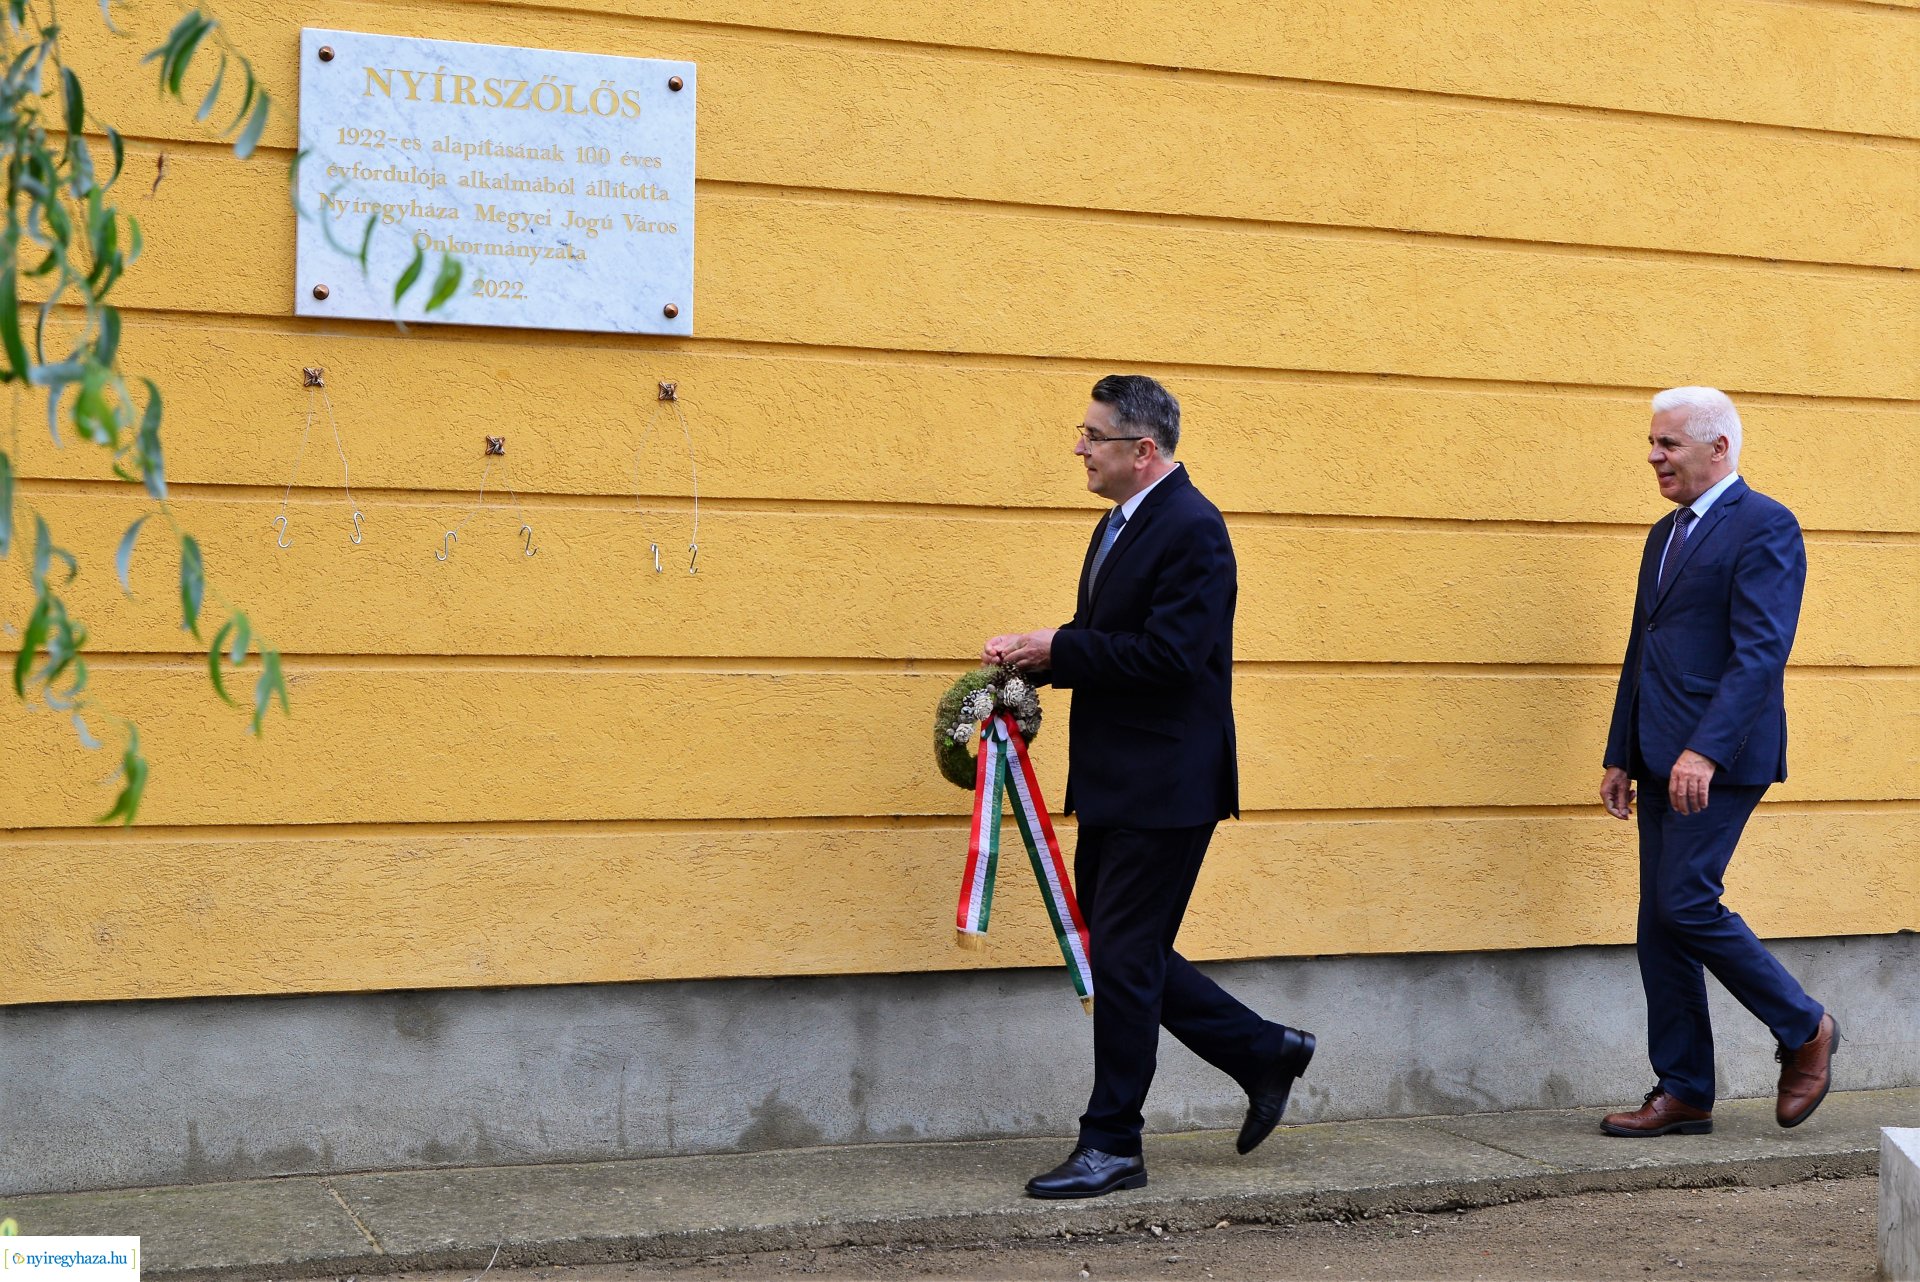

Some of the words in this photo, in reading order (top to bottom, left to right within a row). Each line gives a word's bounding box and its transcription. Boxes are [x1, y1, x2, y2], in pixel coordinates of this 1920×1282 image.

[362, 66, 642, 119] NYÍRSZŐLŐS
[337, 127, 422, 151] 1922-es
[432, 136, 564, 164] alapításának
[576, 146, 610, 165] 100
[620, 151, 662, 169] éves
[326, 161, 447, 187] évfordulója
[458, 172, 575, 195] alkalmából
[585, 178, 670, 201] állította
[318, 192, 459, 223] Nyíregyháza
[474, 203, 551, 233] Megyei
[561, 209, 613, 238] Jogú
[622, 213, 678, 234] Város
[412, 231, 587, 269] Önkormányzata
[471, 279, 528, 300] 2022.
